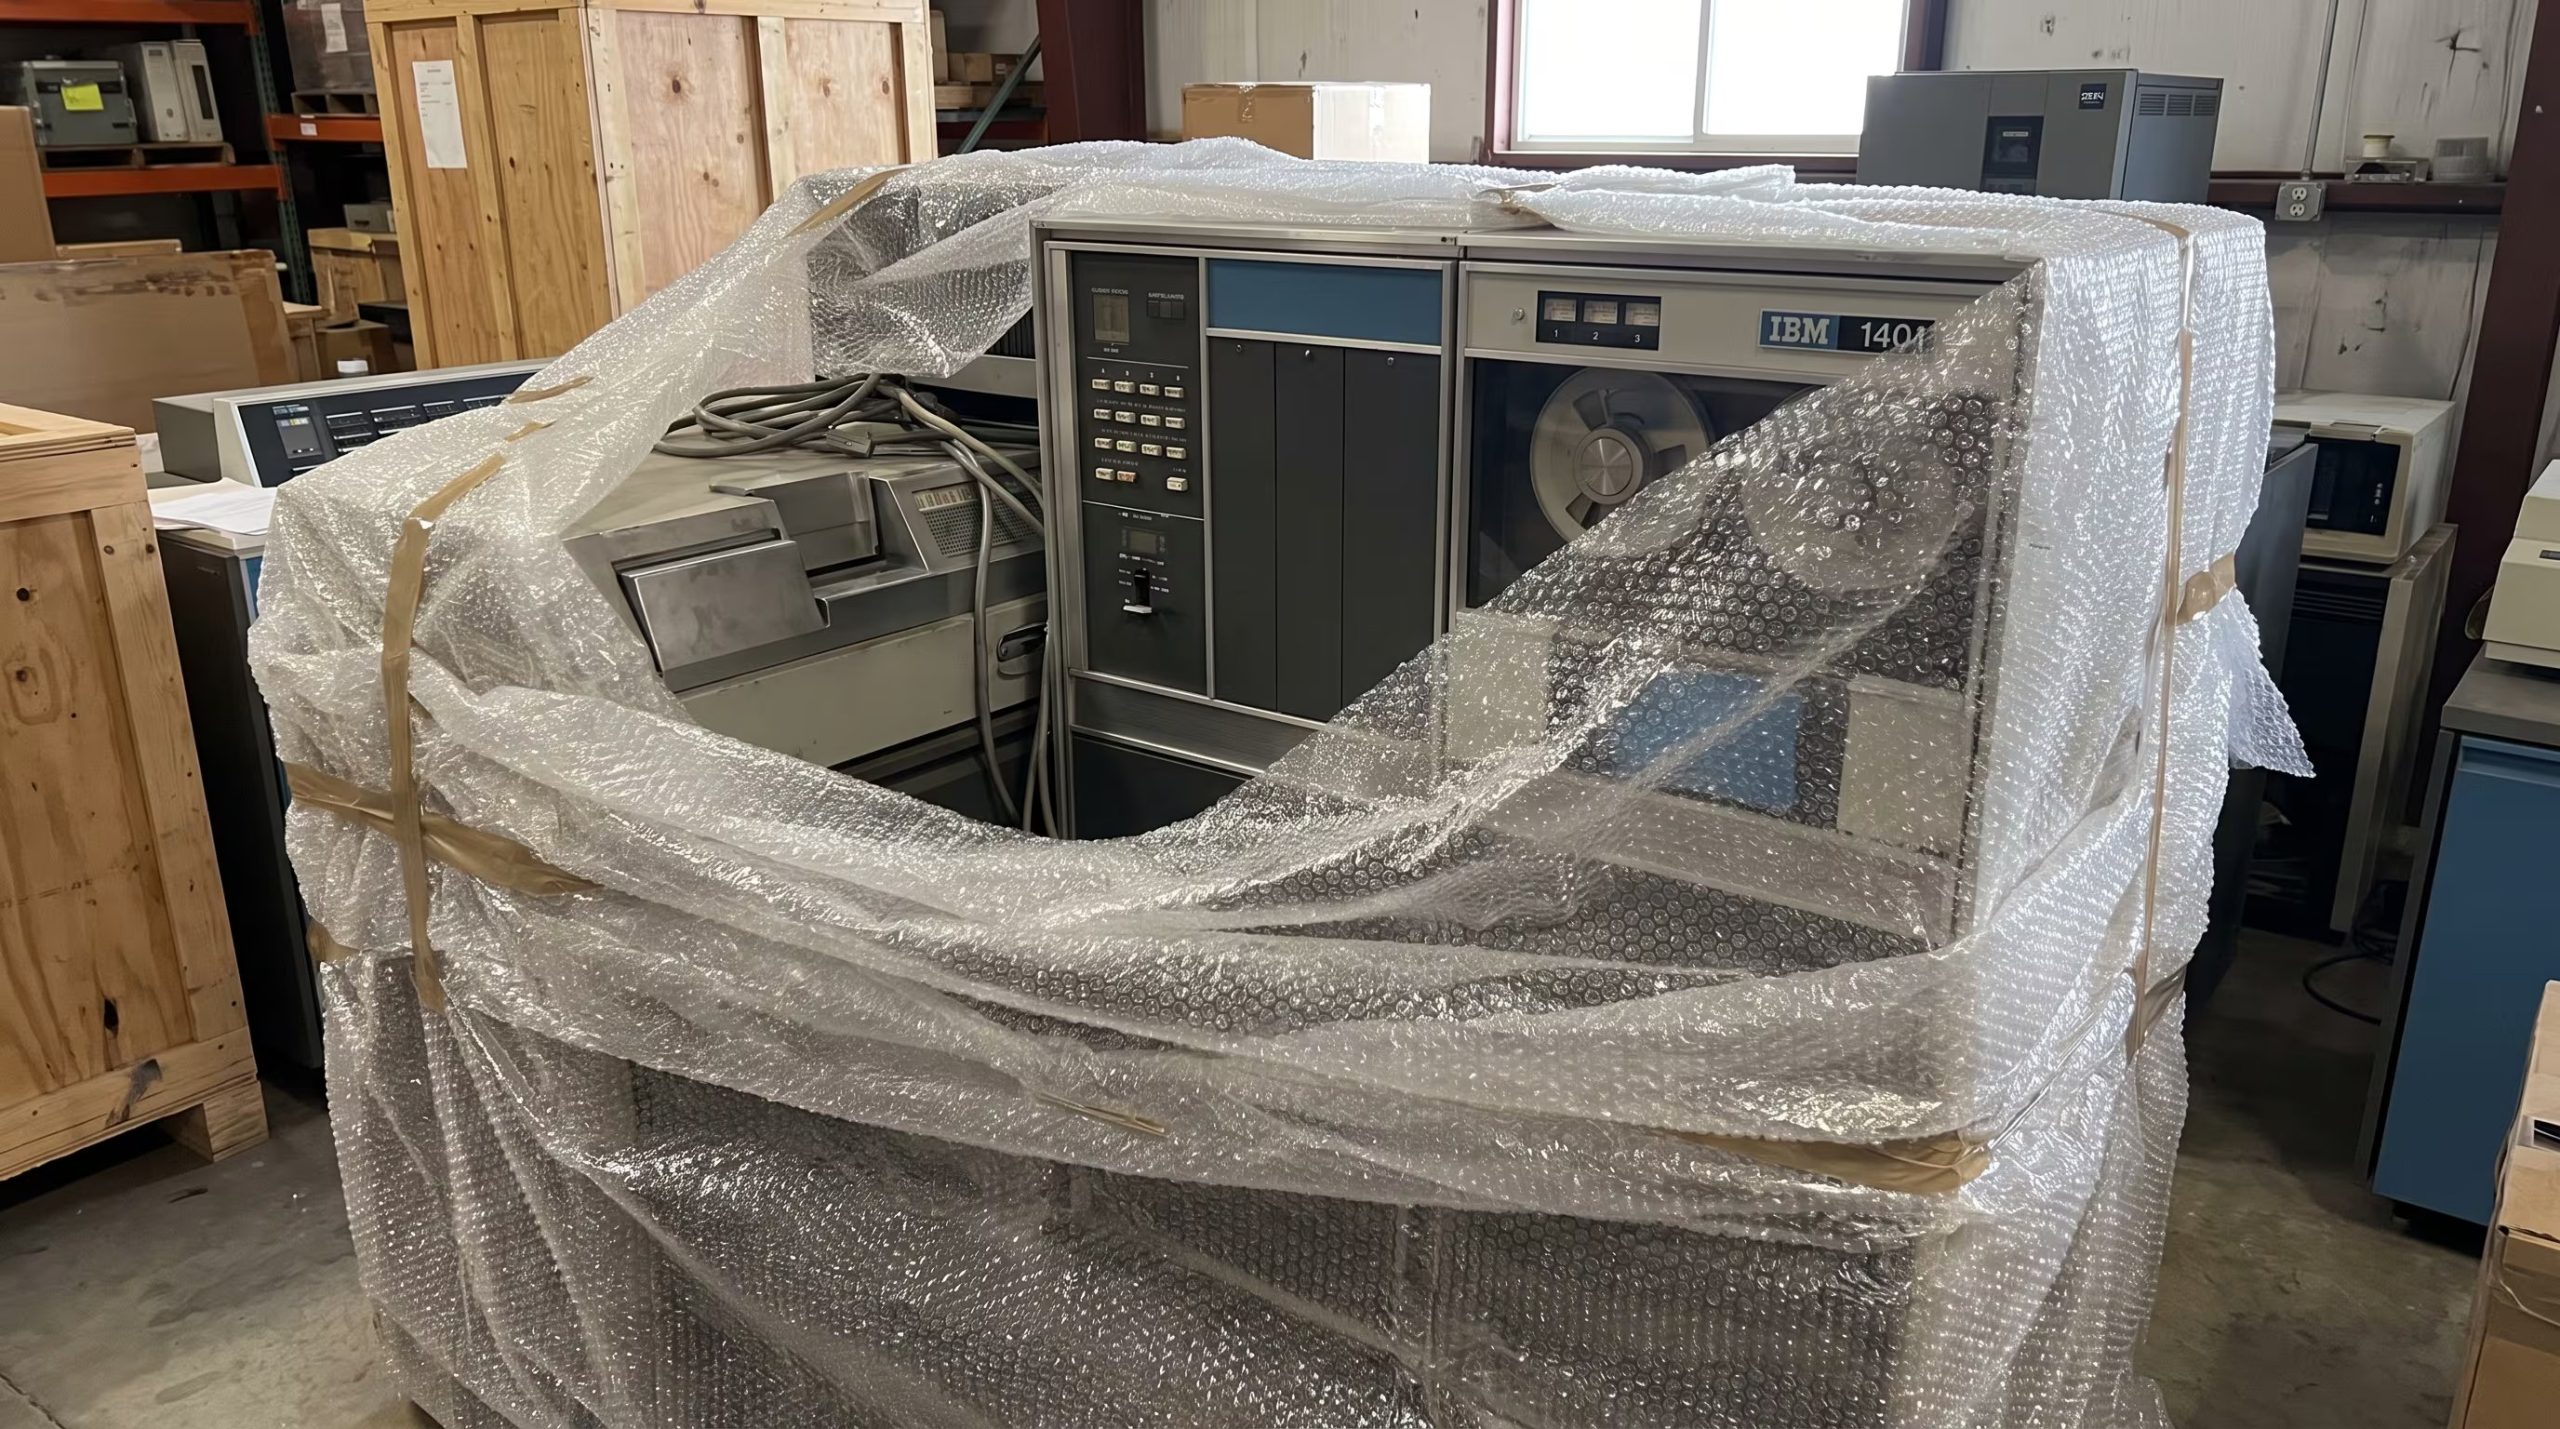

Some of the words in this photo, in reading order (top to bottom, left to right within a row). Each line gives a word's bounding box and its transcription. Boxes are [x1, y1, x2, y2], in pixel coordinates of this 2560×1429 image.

[1592, 331, 1599, 340] 2
[1634, 334, 1641, 343] 3
[1769, 315, 1830, 345] IBM
[1861, 321, 1924, 353] 1401
